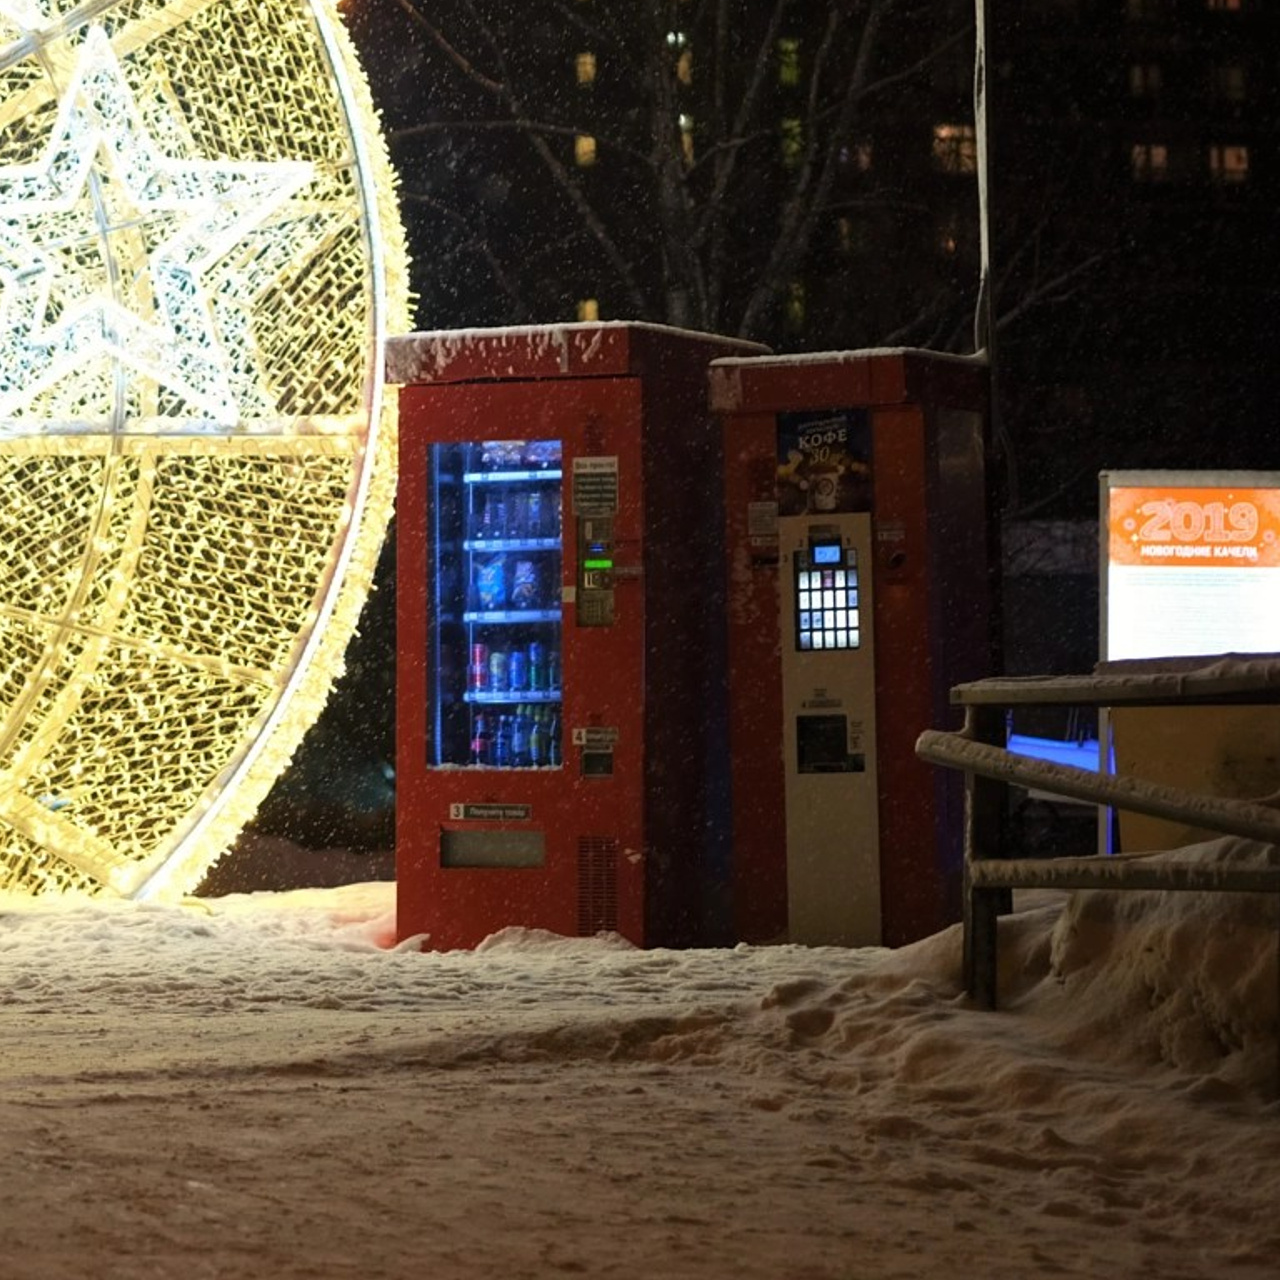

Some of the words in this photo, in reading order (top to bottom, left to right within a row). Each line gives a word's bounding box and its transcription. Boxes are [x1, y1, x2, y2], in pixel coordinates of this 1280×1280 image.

[799, 428, 848, 450] КОФЕ
[1139, 500, 1259, 542] 2019
[1141, 545, 1211, 558] НОВОГОДНИЕ
[1213, 546, 1258, 559] КАЧЕЛИ
[575, 731, 583, 742] 4
[453, 805, 460, 818] 3
